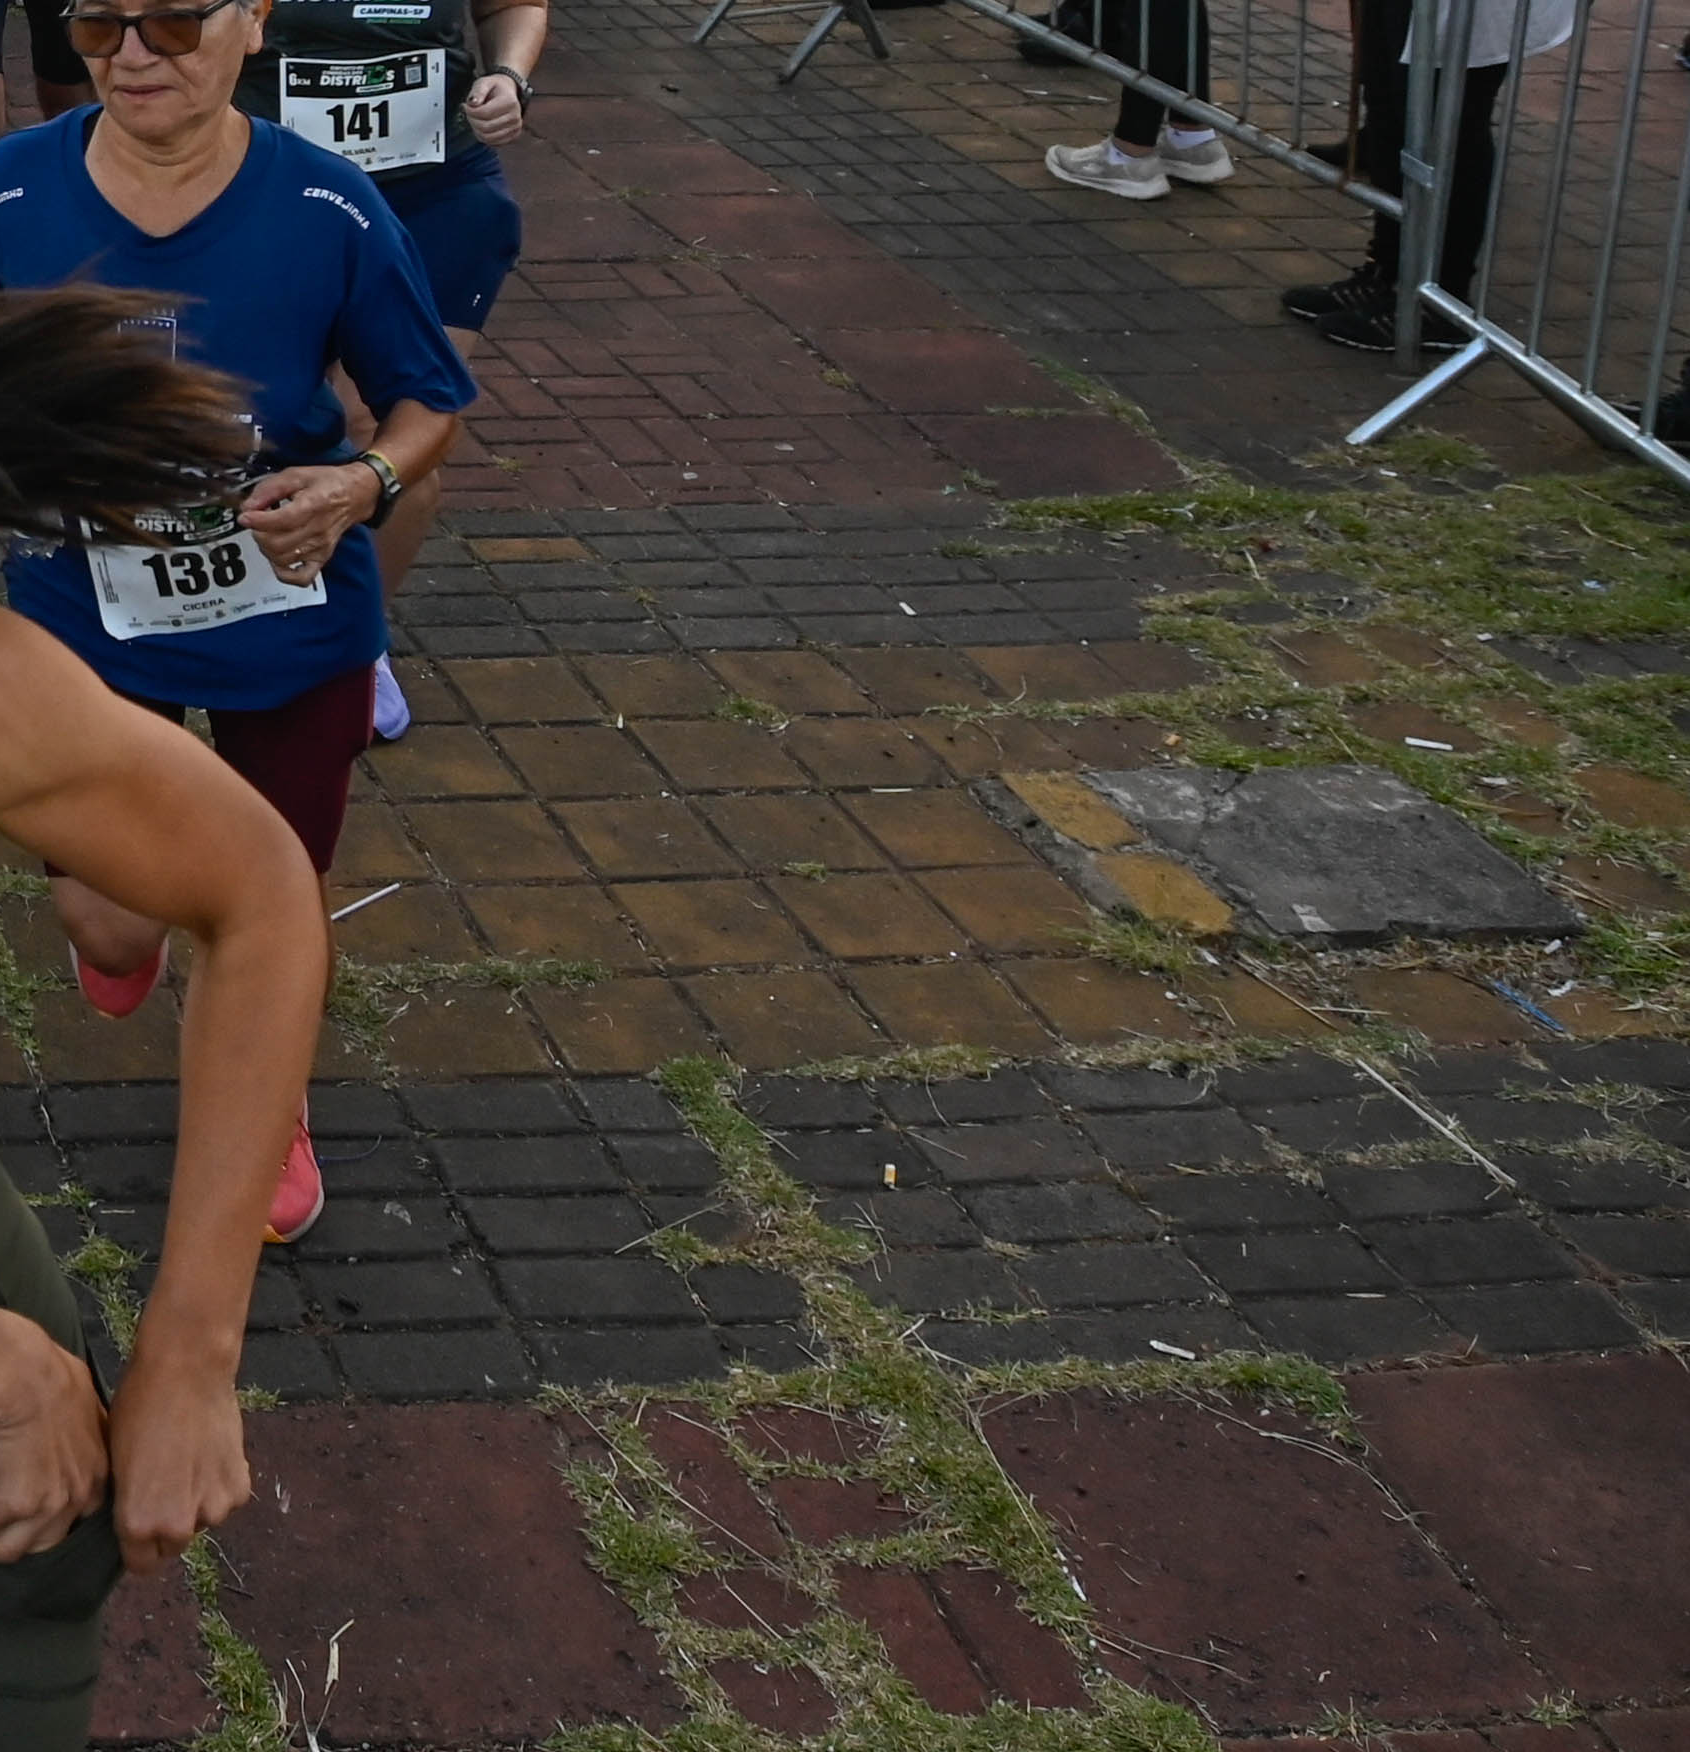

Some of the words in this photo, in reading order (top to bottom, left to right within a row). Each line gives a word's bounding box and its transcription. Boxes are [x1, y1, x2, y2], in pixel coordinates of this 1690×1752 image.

[360, 7, 424, 15] CAMPINAS-SP
[288, 73, 311, 86] 6KM
[326, 100, 390, 142] 141
[303, 187, 370, 231] CERVEJINHA
[142, 542, 247, 597] 138
[182, 598, 225, 612] CICERA
